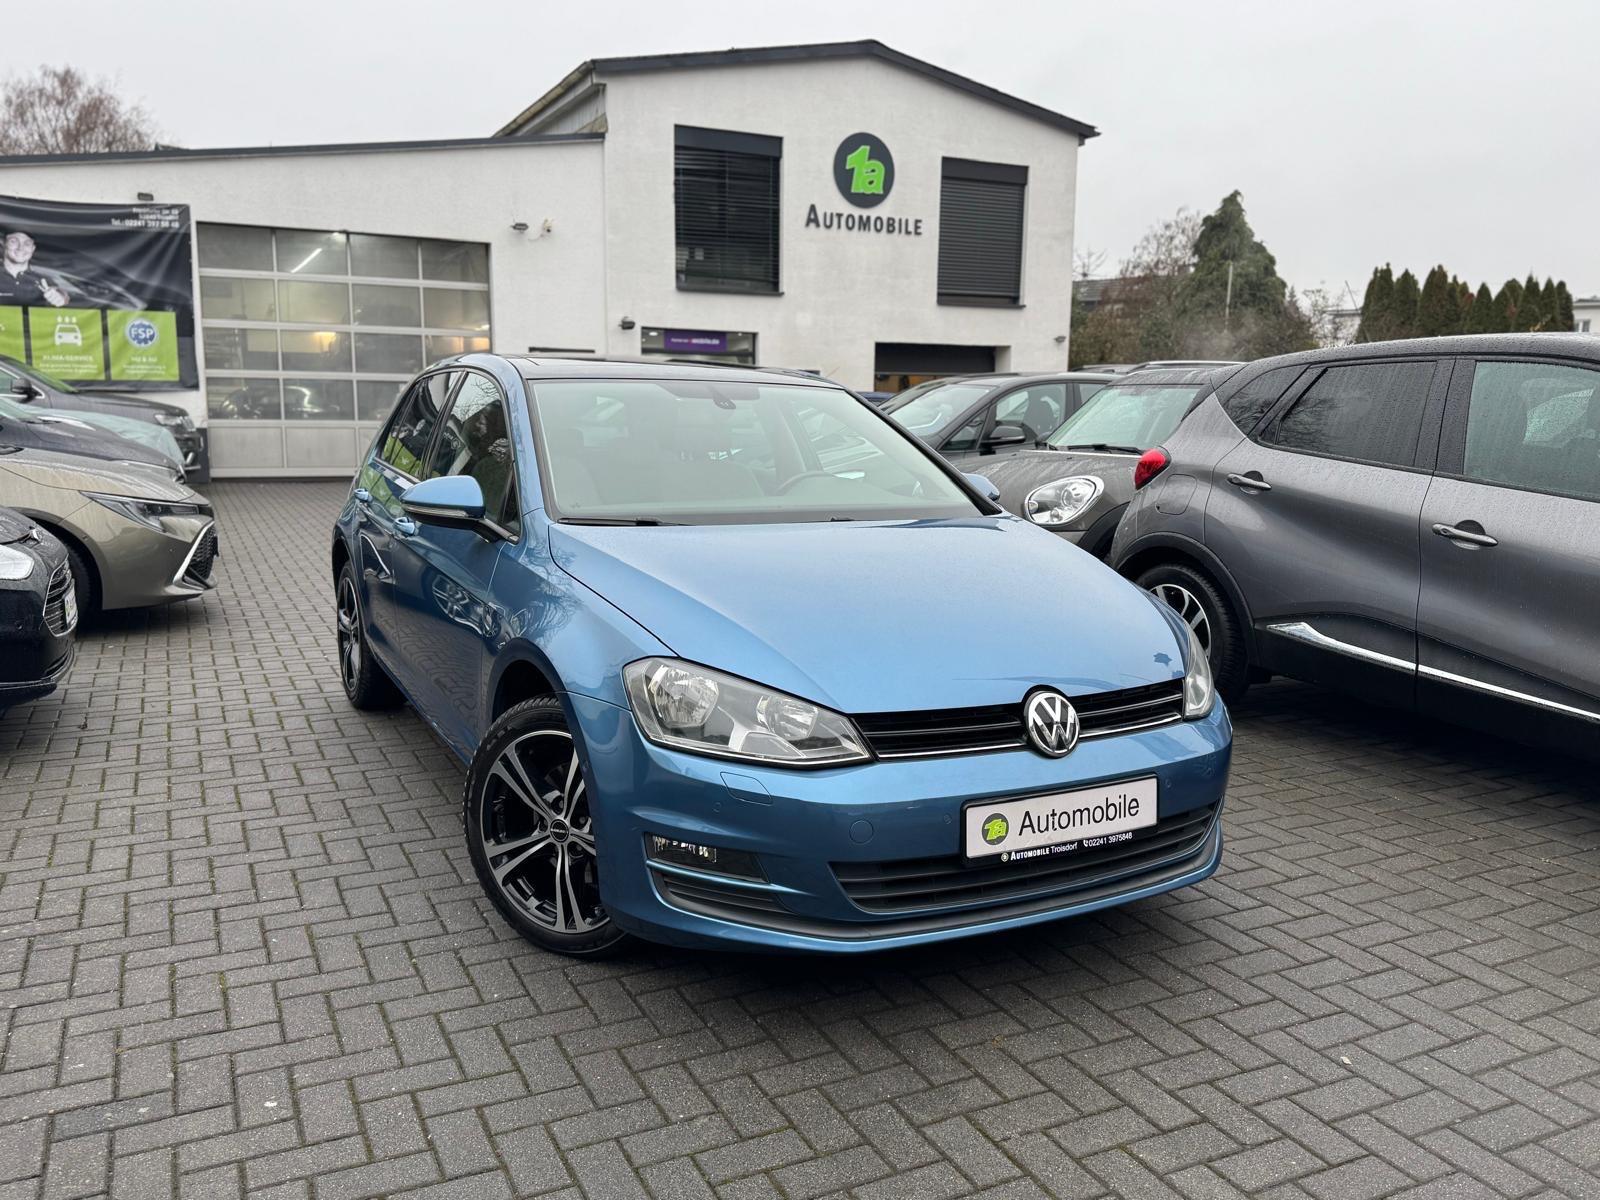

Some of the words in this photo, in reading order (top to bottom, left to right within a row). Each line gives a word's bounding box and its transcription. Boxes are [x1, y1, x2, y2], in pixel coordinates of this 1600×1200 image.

[845, 145, 885, 195] 1a
[805, 204, 923, 236] AUTOMOBILE
[130, 327, 154, 339] FSP
[1018, 794, 1140, 836] Automobile
[1010, 847, 1050, 861] AUTOMOBILE
[1050, 842, 1078, 855] Troisdorf
[1088, 836, 1107, 847] 02241
